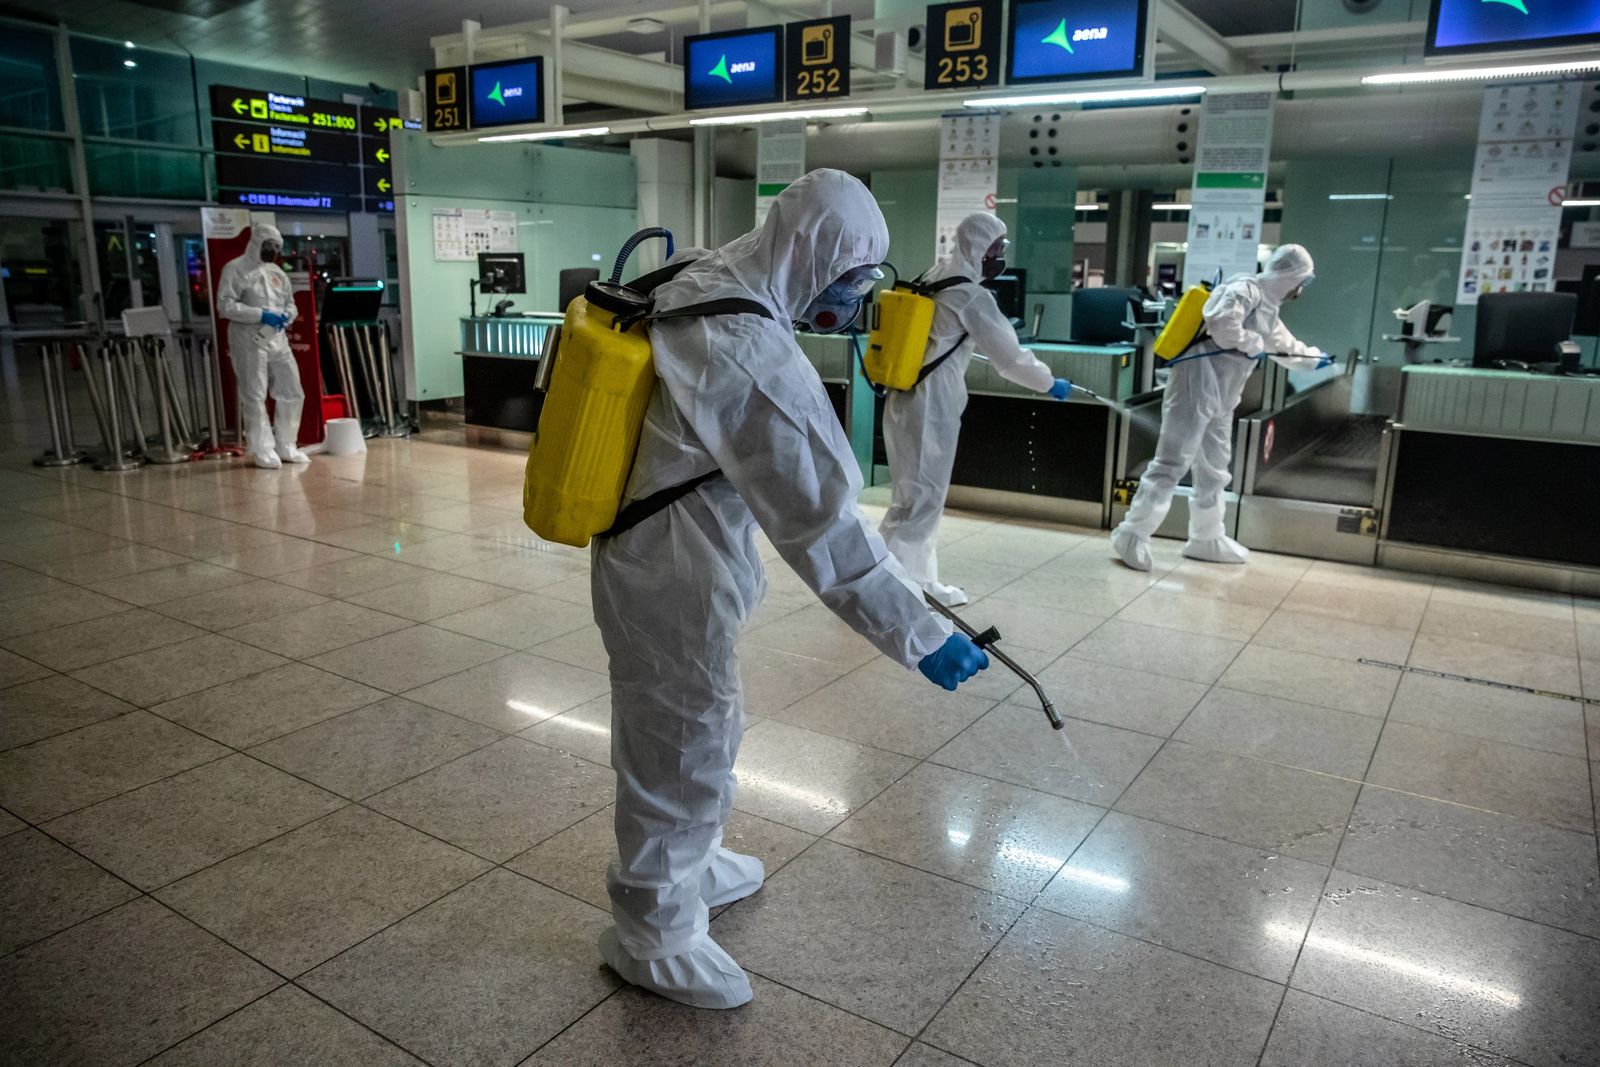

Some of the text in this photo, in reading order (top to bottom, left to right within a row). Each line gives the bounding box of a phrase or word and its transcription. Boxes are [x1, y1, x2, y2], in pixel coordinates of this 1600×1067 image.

[1073, 26, 1108, 42] aena
[730, 60, 756, 74] aena
[938, 54, 988, 84] 253
[796, 68, 840, 96] 252
[503, 86, 523, 98] aena
[434, 107, 460, 127] 251
